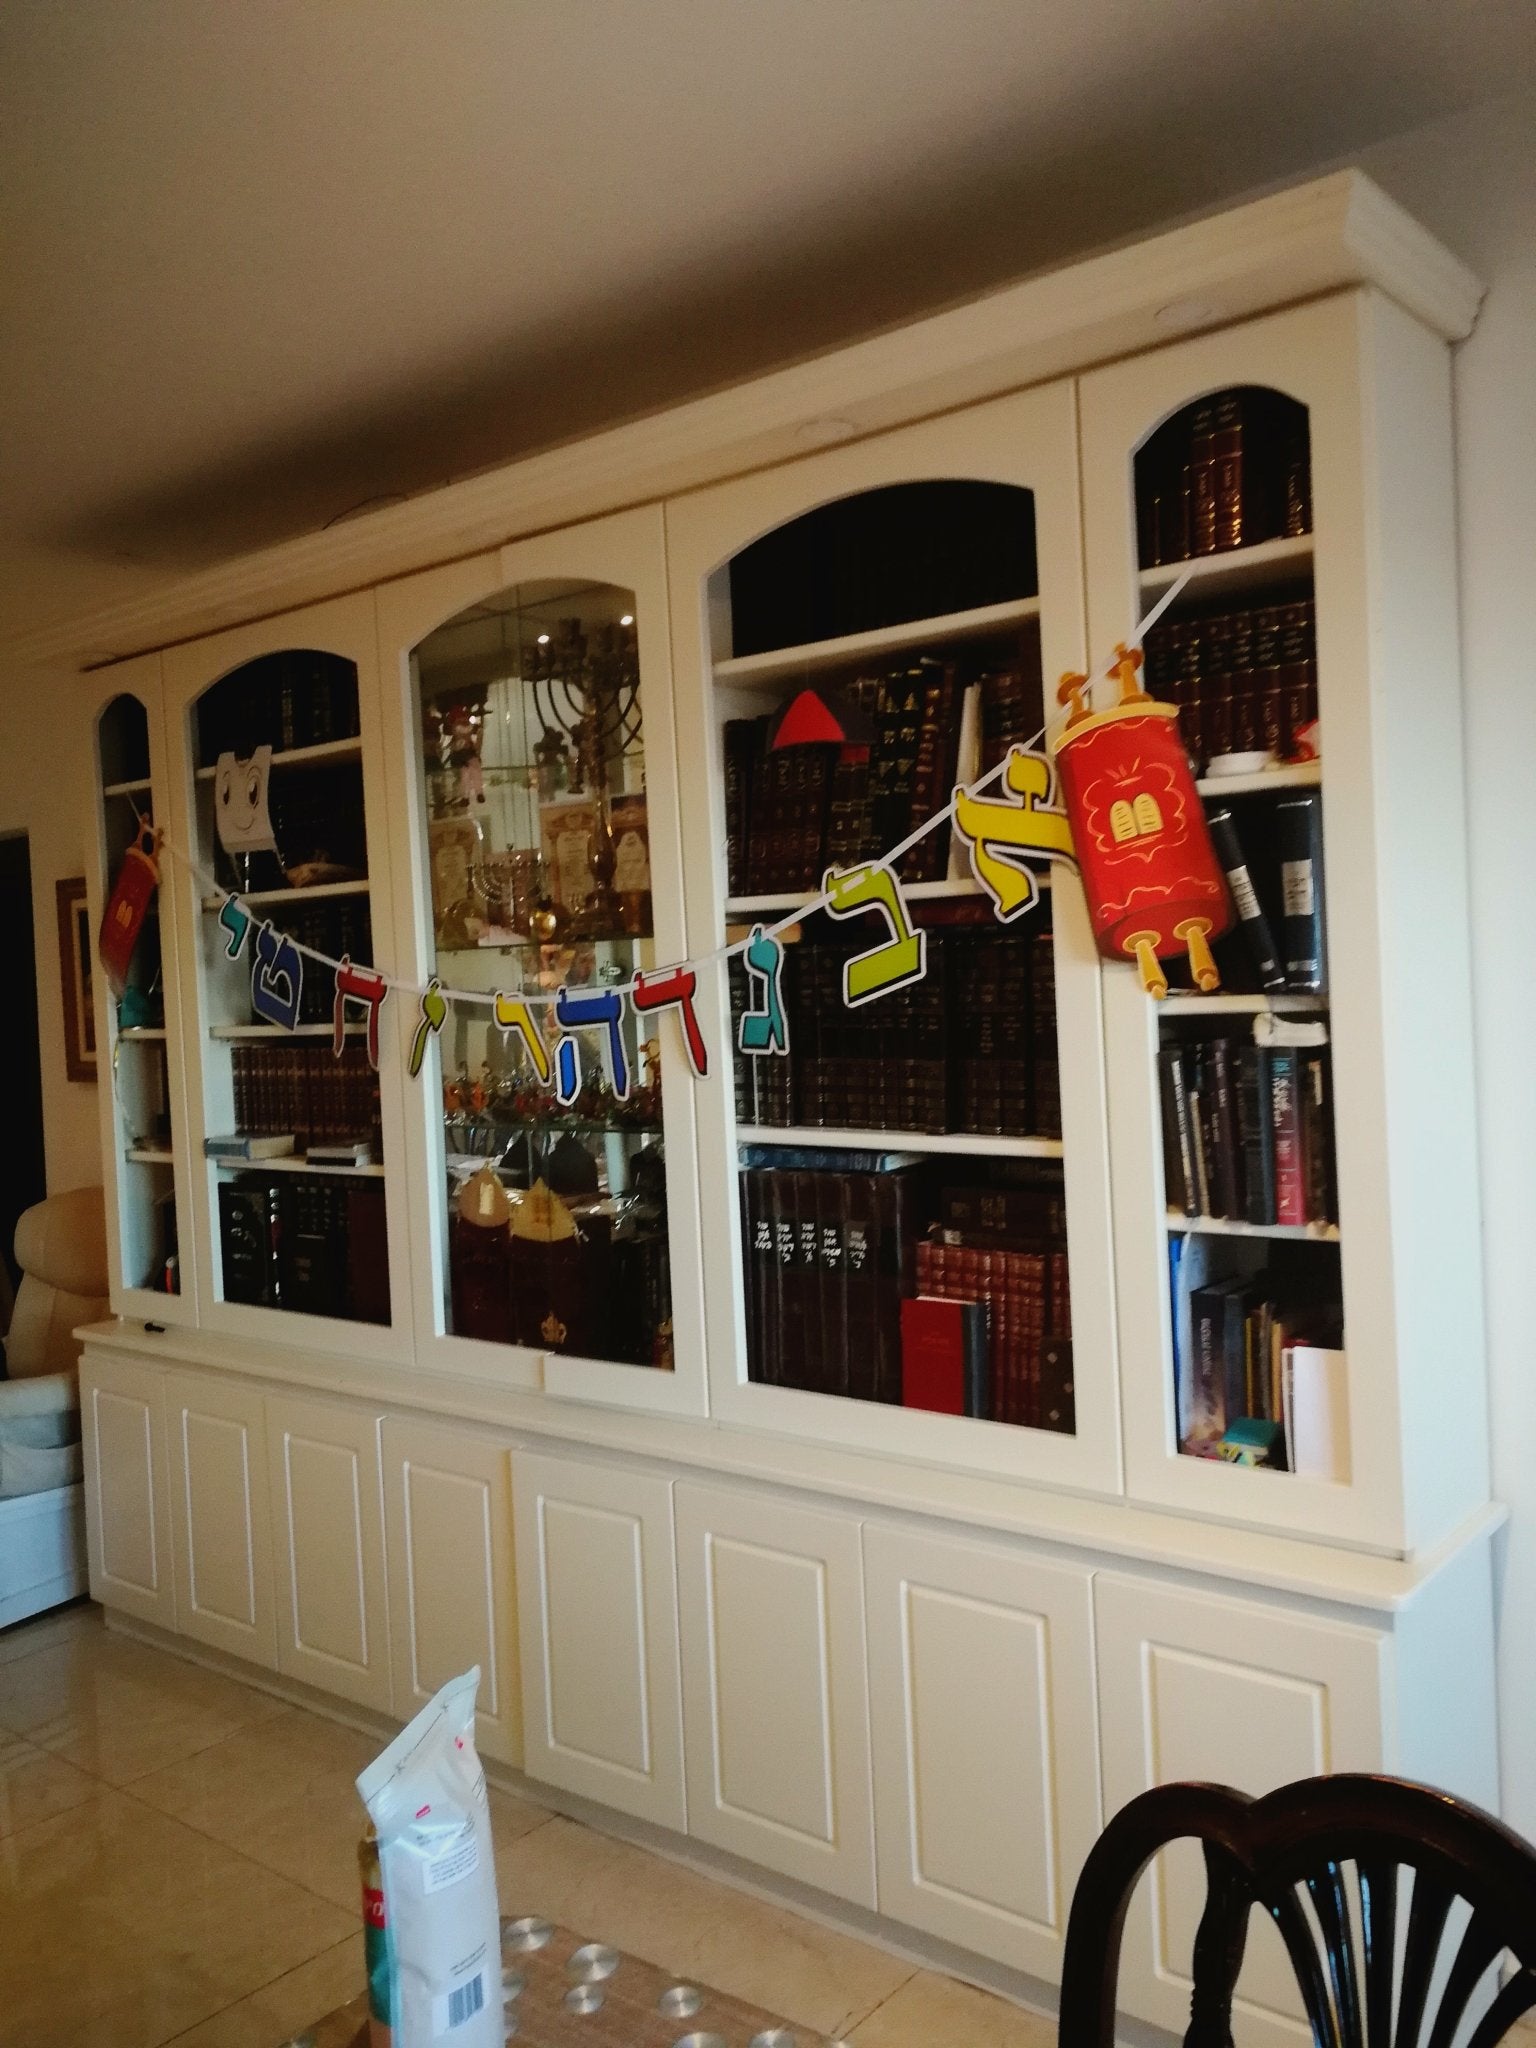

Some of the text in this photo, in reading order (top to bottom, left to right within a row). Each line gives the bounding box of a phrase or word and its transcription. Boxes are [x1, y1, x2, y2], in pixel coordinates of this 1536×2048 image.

[218, 747, 1079, 1101] א ב ג ד ה ו ז ח ט י
